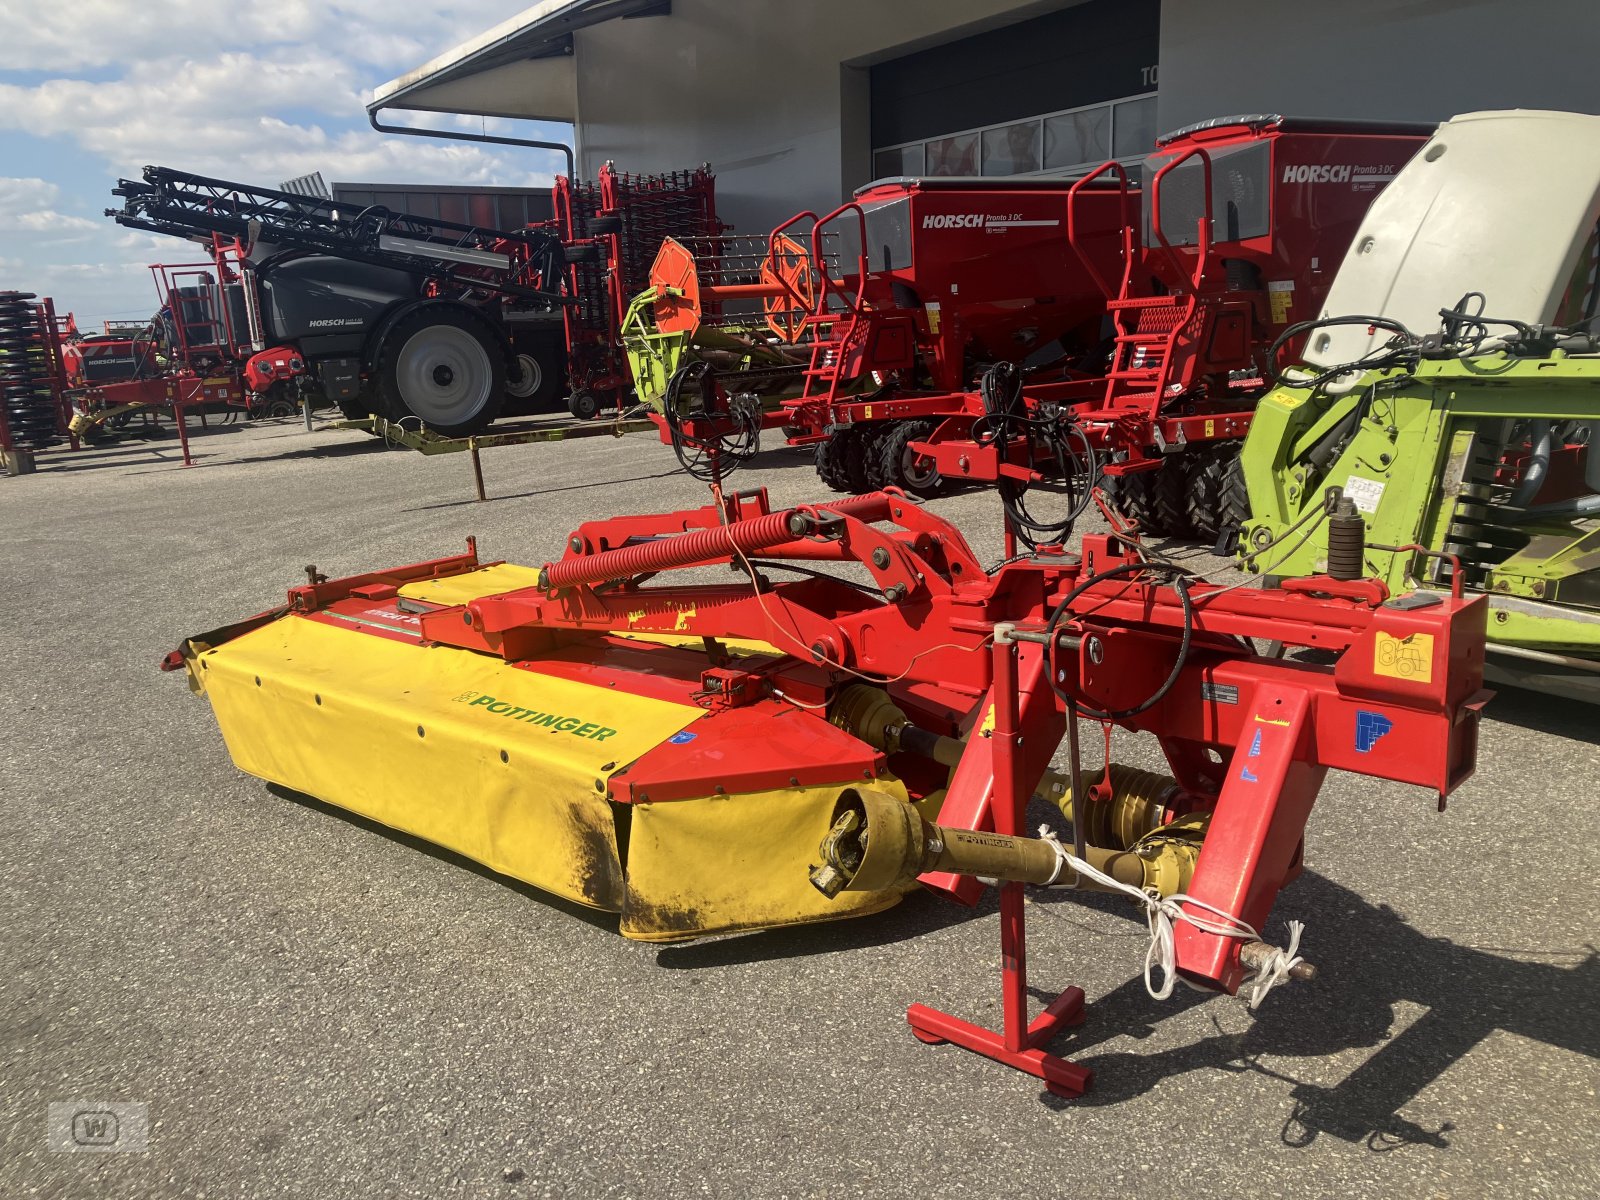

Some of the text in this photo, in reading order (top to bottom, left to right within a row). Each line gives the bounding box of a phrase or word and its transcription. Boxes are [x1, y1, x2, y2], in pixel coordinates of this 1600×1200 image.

[1282, 164, 1396, 183] HORSCH Pronto 3 DC
[922, 213, 1023, 229] HORSCH Pronto 3 DC
[309, 318, 345, 327] HORSCH
[88, 358, 116, 366] HORSCH
